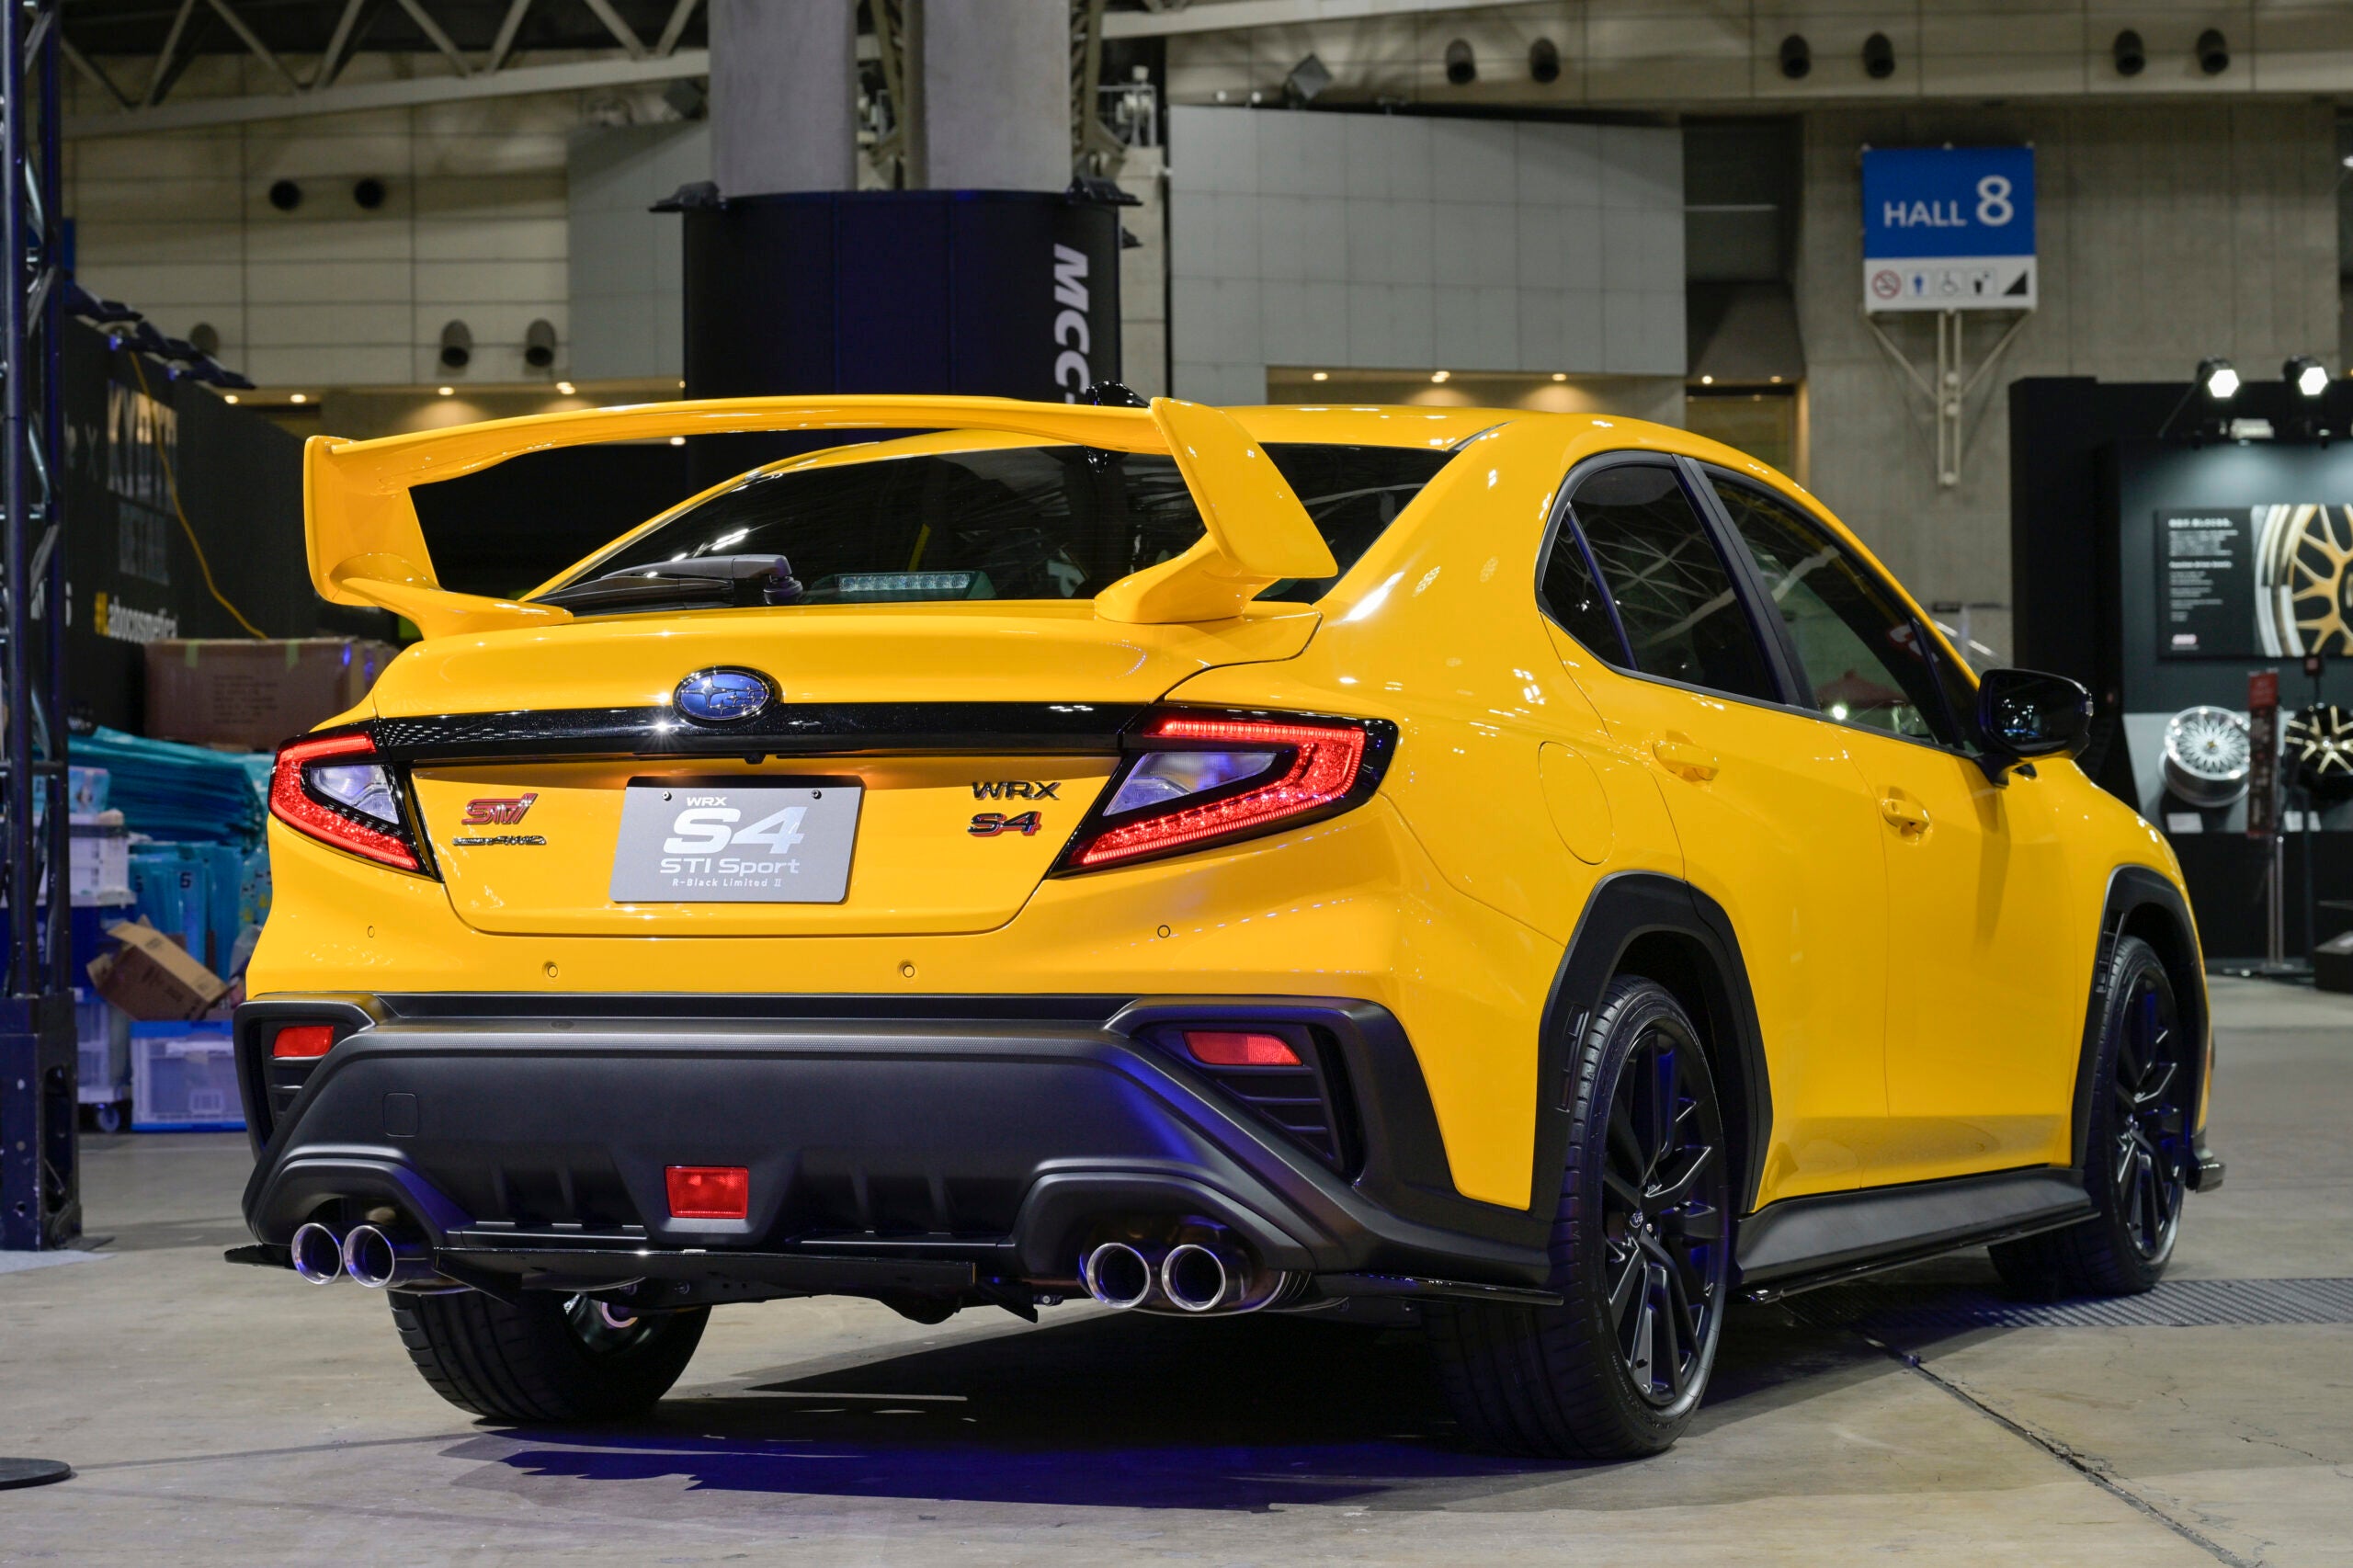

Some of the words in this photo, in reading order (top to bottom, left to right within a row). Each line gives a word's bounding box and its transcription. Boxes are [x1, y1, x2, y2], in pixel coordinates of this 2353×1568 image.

[1883, 199, 1967, 228] HALL
[1975, 174, 2015, 227] 8
[972, 781, 1062, 801] WRX
[686, 796, 727, 807] WRX
[663, 806, 808, 855] S4
[967, 811, 1042, 837] S4
[659, 858, 710, 874] STI
[718, 858, 801, 877] Sport
[672, 878, 718, 887] R-Black
[722, 878, 767, 887] Limited
